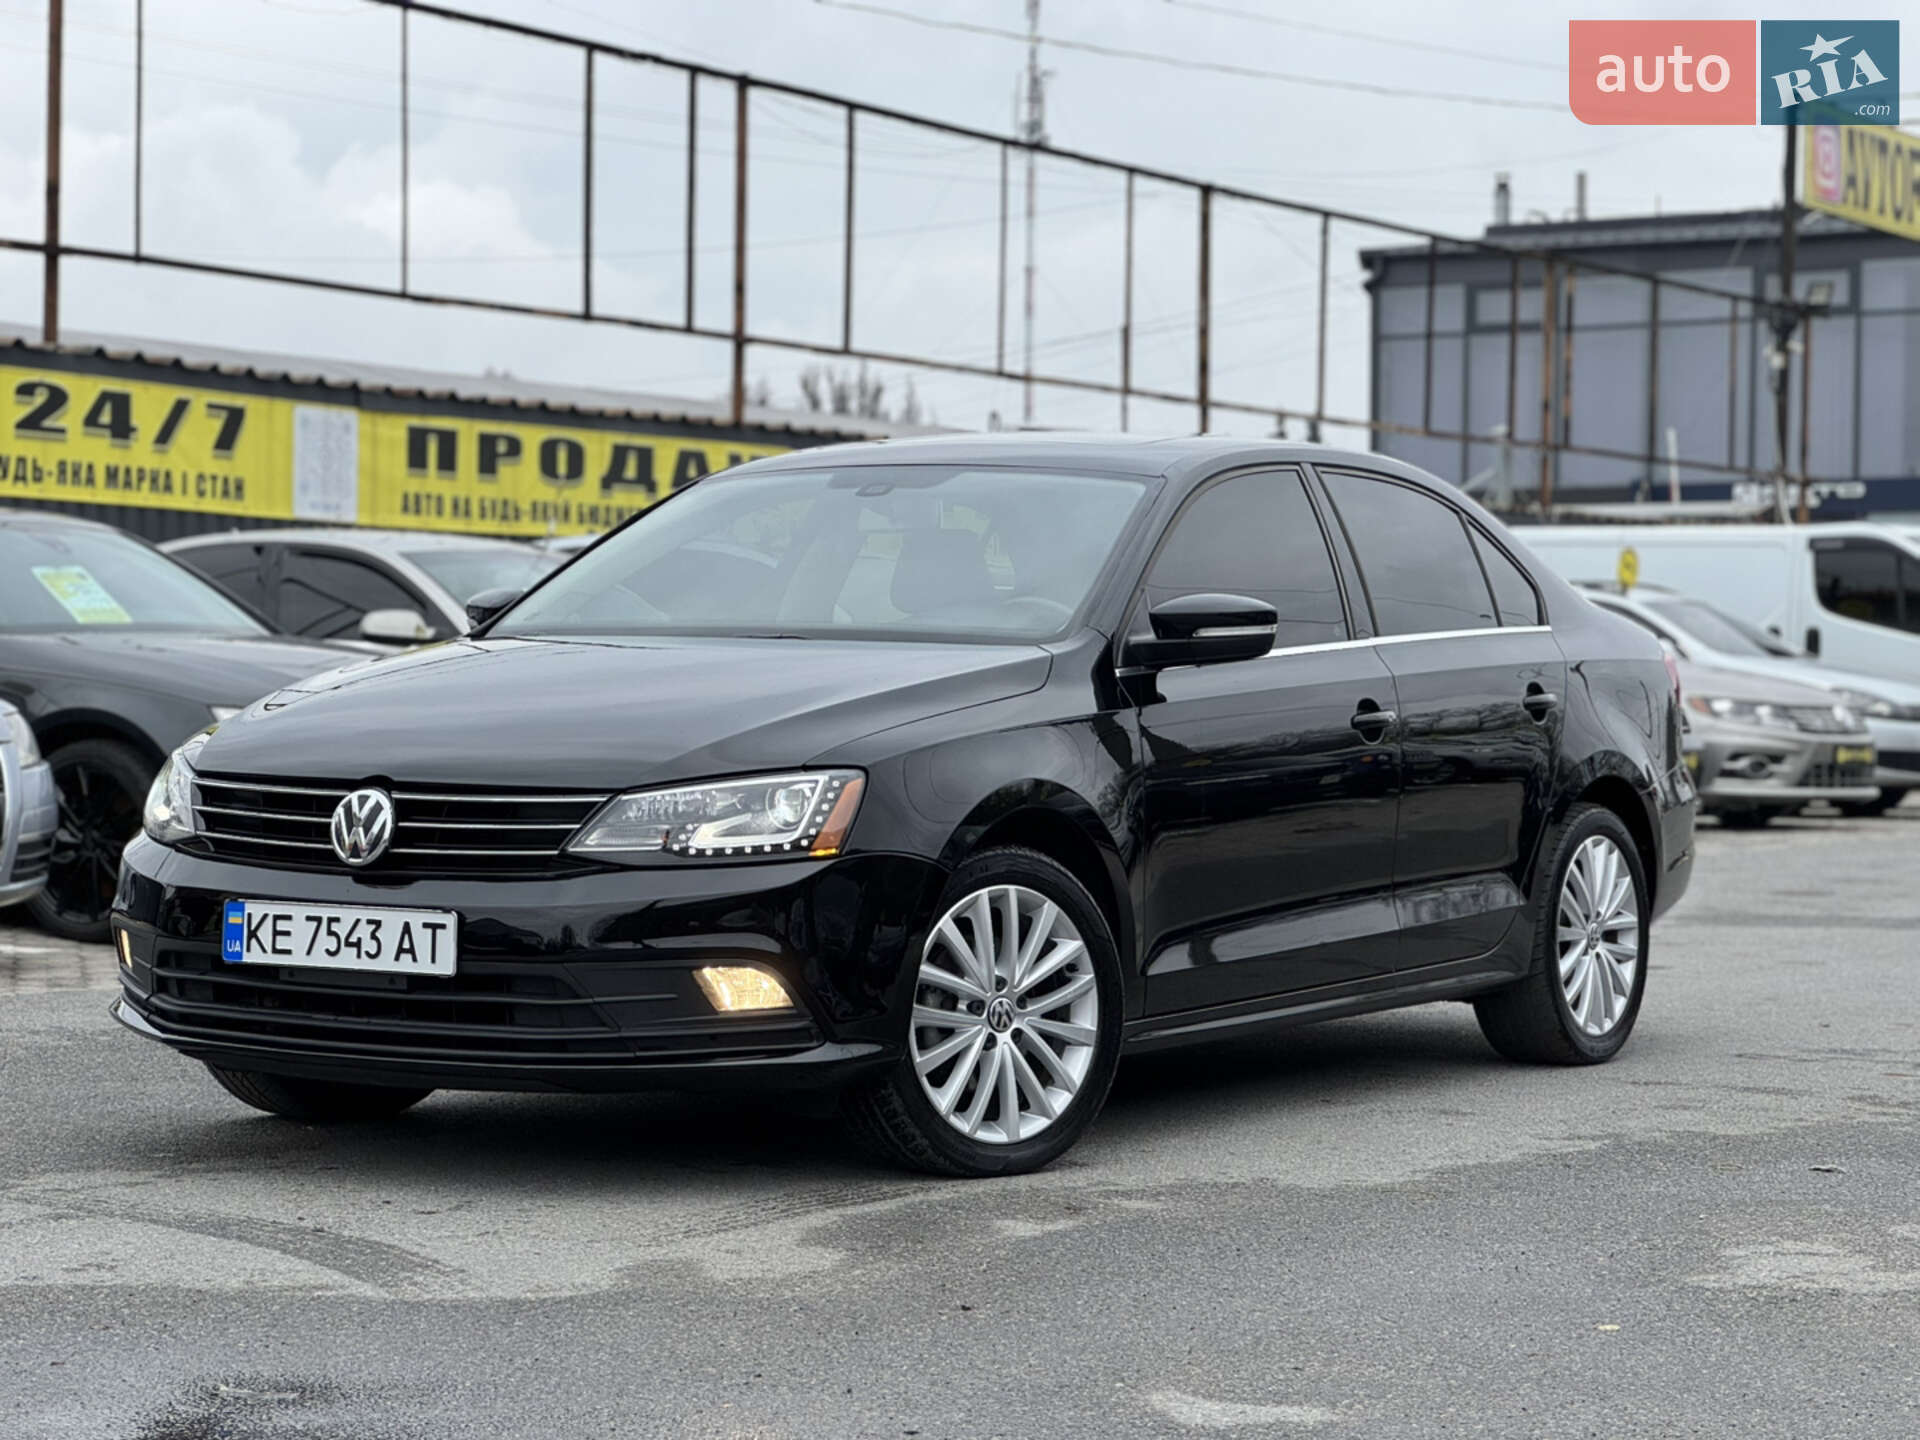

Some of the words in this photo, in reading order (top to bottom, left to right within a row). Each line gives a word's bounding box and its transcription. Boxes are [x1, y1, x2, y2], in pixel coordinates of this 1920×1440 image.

[13, 381, 247, 456] 24/7
[407, 424, 772, 496] ПРОДА
[105, 464, 173, 495] МАРКА
[196, 472, 245, 502] СТАН
[402, 491, 445, 518] АВТО
[227, 939, 242, 953] UA
[246, 911, 293, 955] KE
[305, 914, 382, 960] 7543
[394, 920, 447, 964] AT
